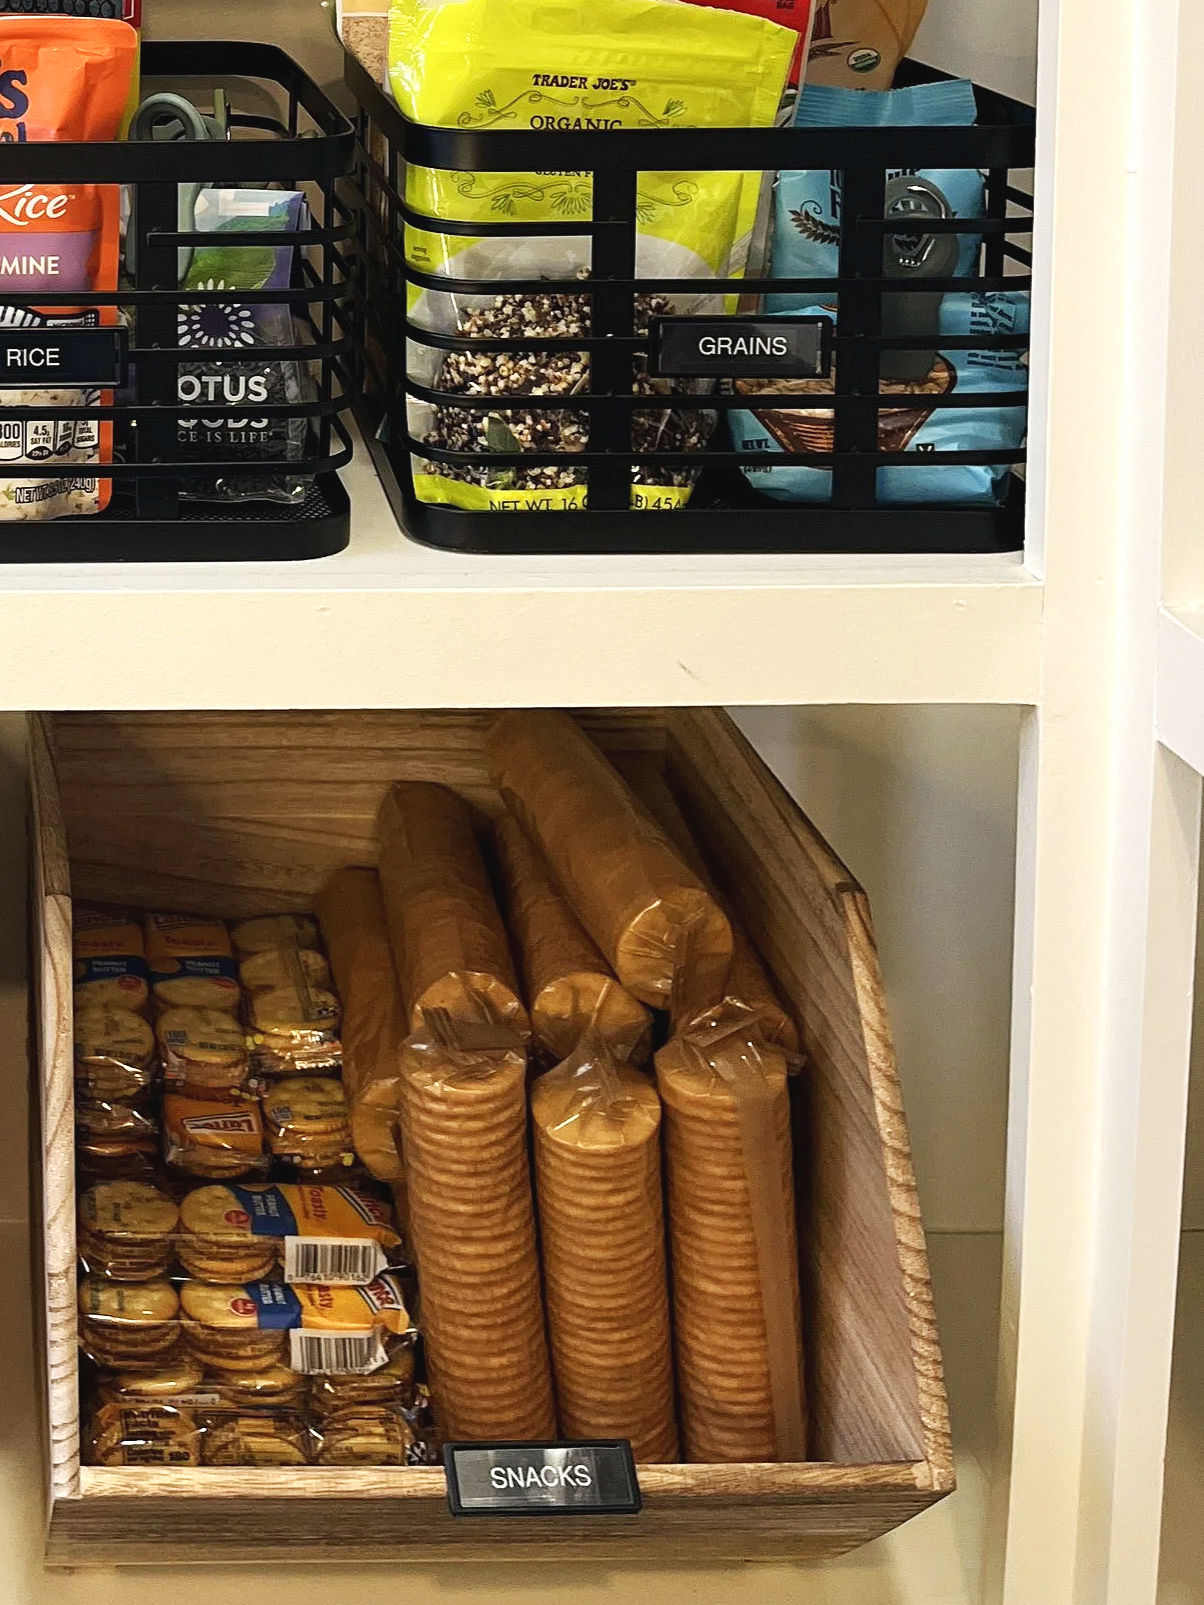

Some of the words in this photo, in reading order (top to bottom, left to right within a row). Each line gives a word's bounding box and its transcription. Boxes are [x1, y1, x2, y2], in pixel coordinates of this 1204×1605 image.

[532, 74, 588, 90] TRADER
[591, 78, 630, 91] JOE'S
[698, 336, 788, 356] GRAINS
[6, 348, 61, 367] RICE
[178, 375, 268, 402] OTUS
[207, 431, 222, 442] IS
[230, 431, 269, 443] LIFE
[490, 500, 520, 511] NET
[490, 1464, 592, 1490] SNACKS
